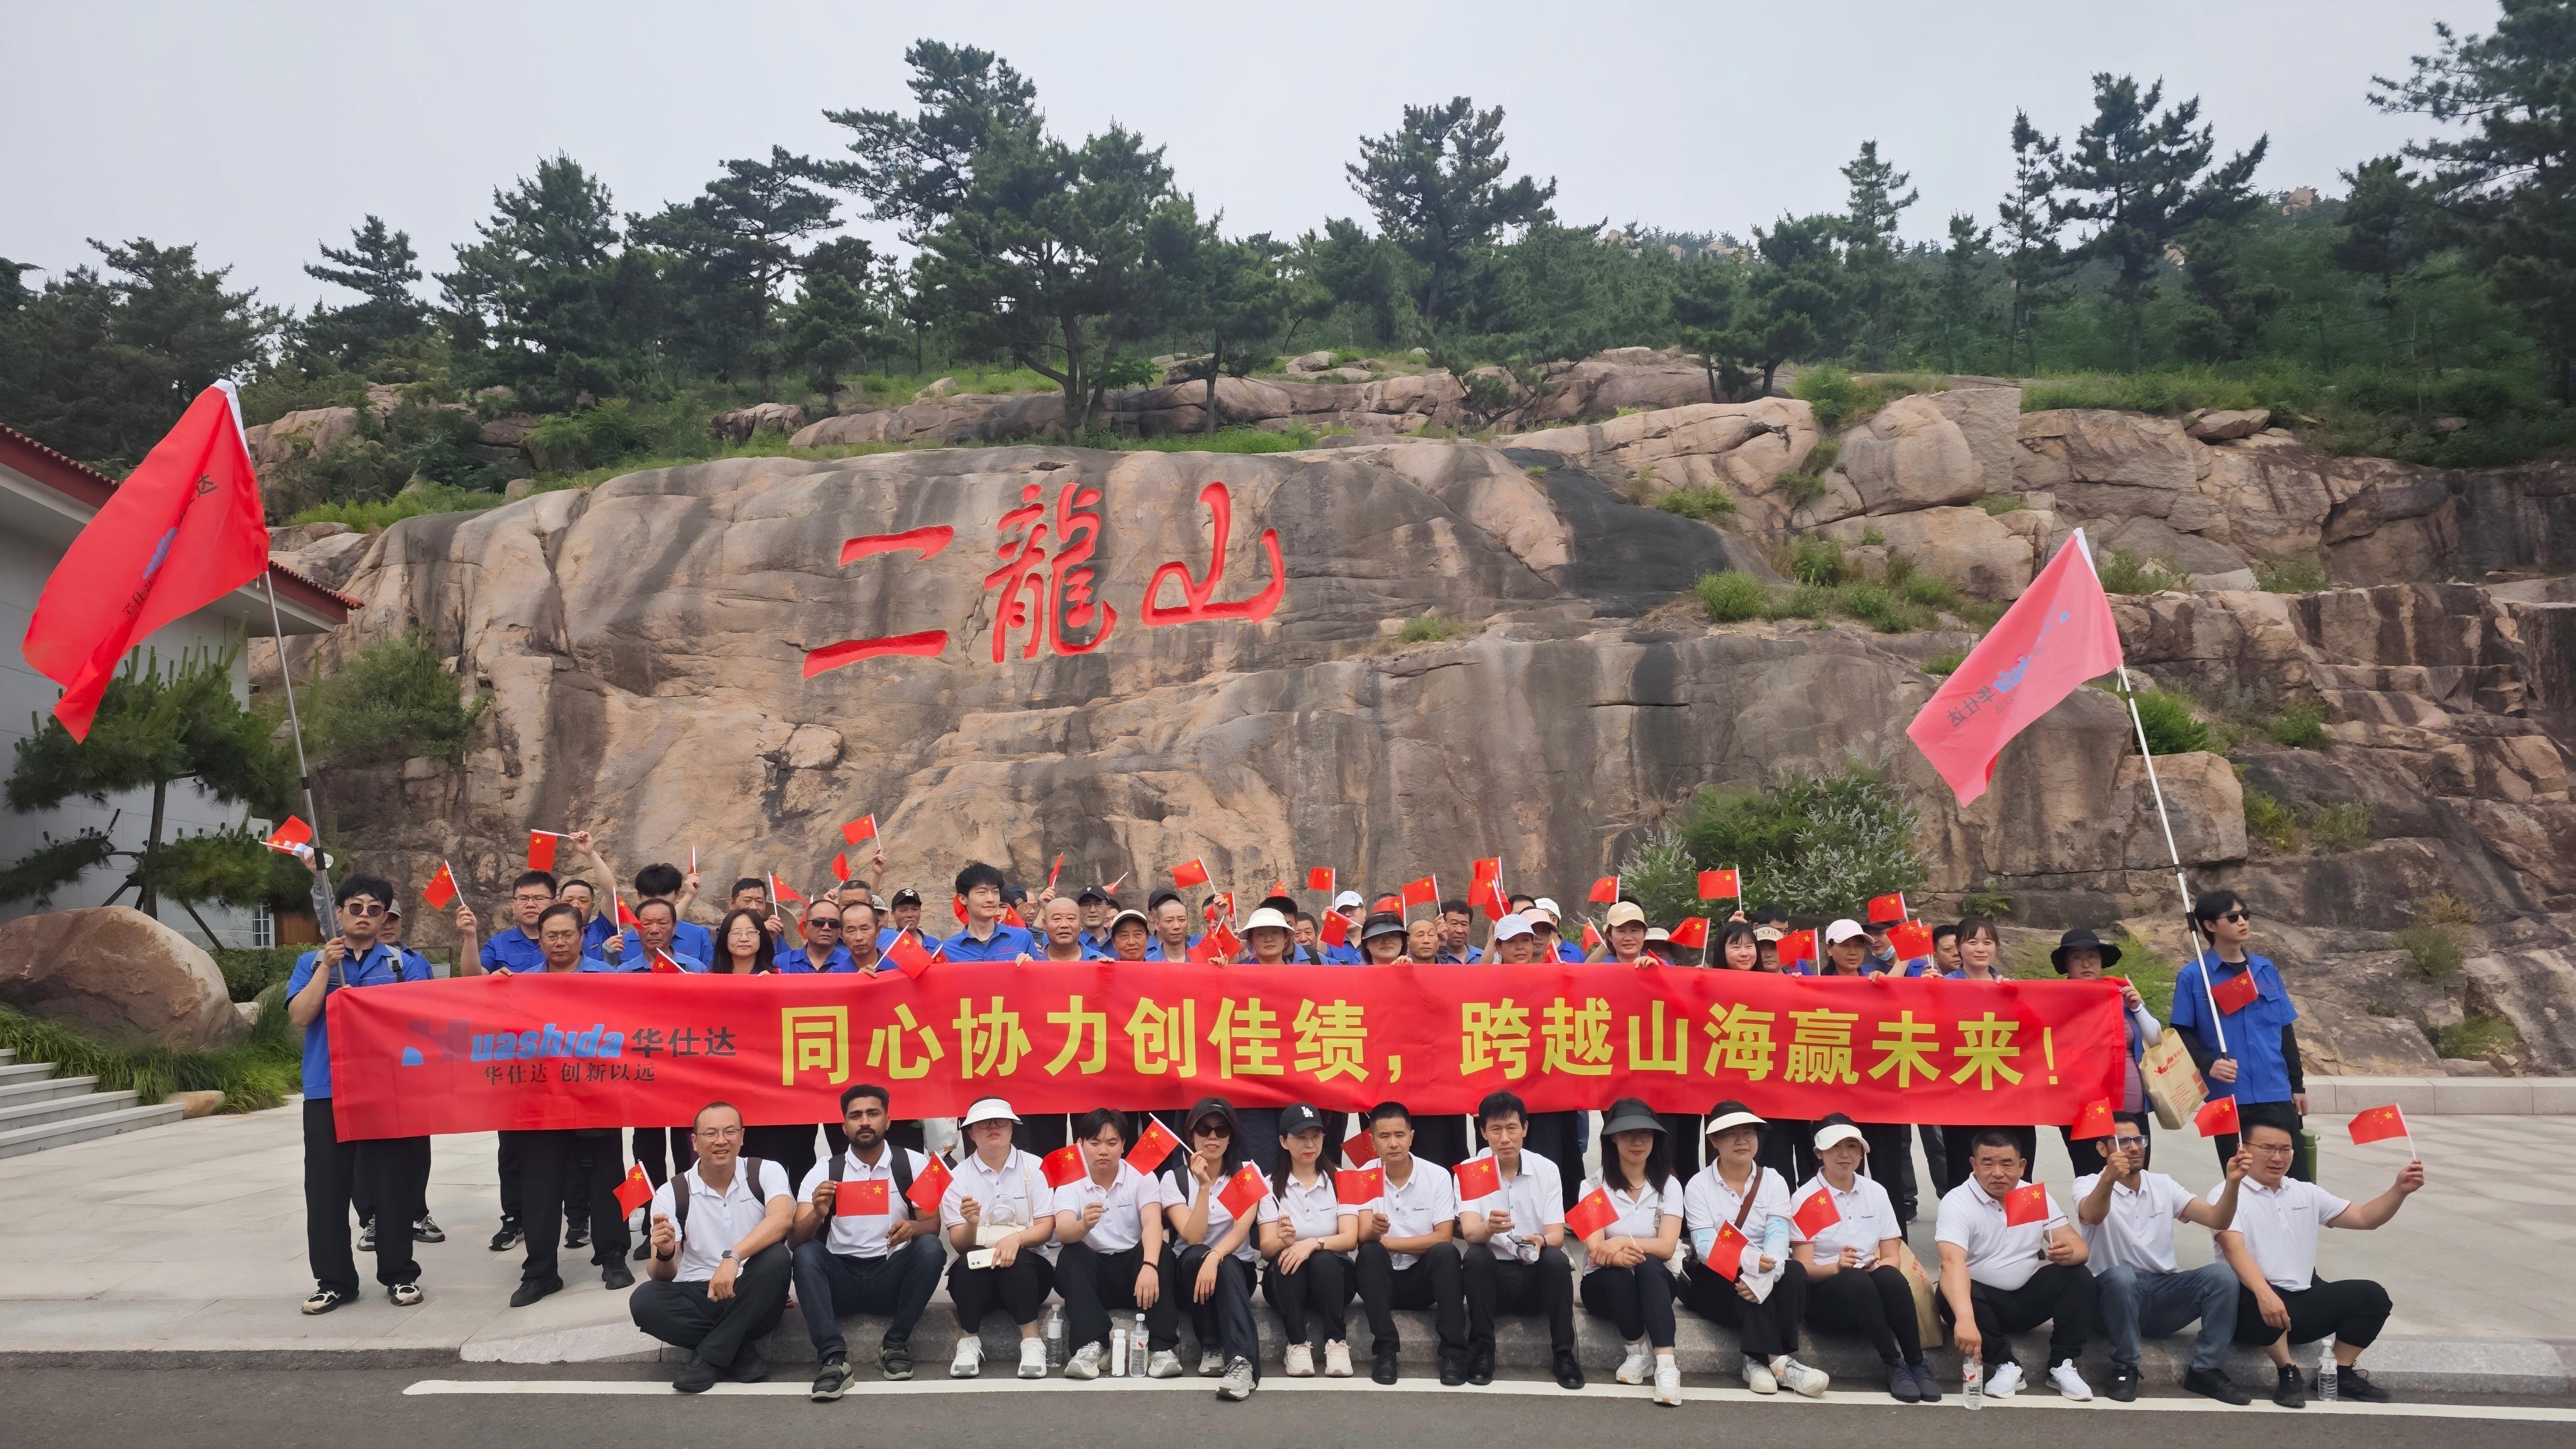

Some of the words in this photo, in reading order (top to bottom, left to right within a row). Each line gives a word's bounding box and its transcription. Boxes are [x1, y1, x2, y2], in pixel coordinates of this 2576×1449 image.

[631, 1027, 736, 1058] 华仕达
[483, 1065, 548, 1086] 华仕达
[560, 1062, 655, 1085] 创新以远
[1301, 1106, 1314, 1118] LA
